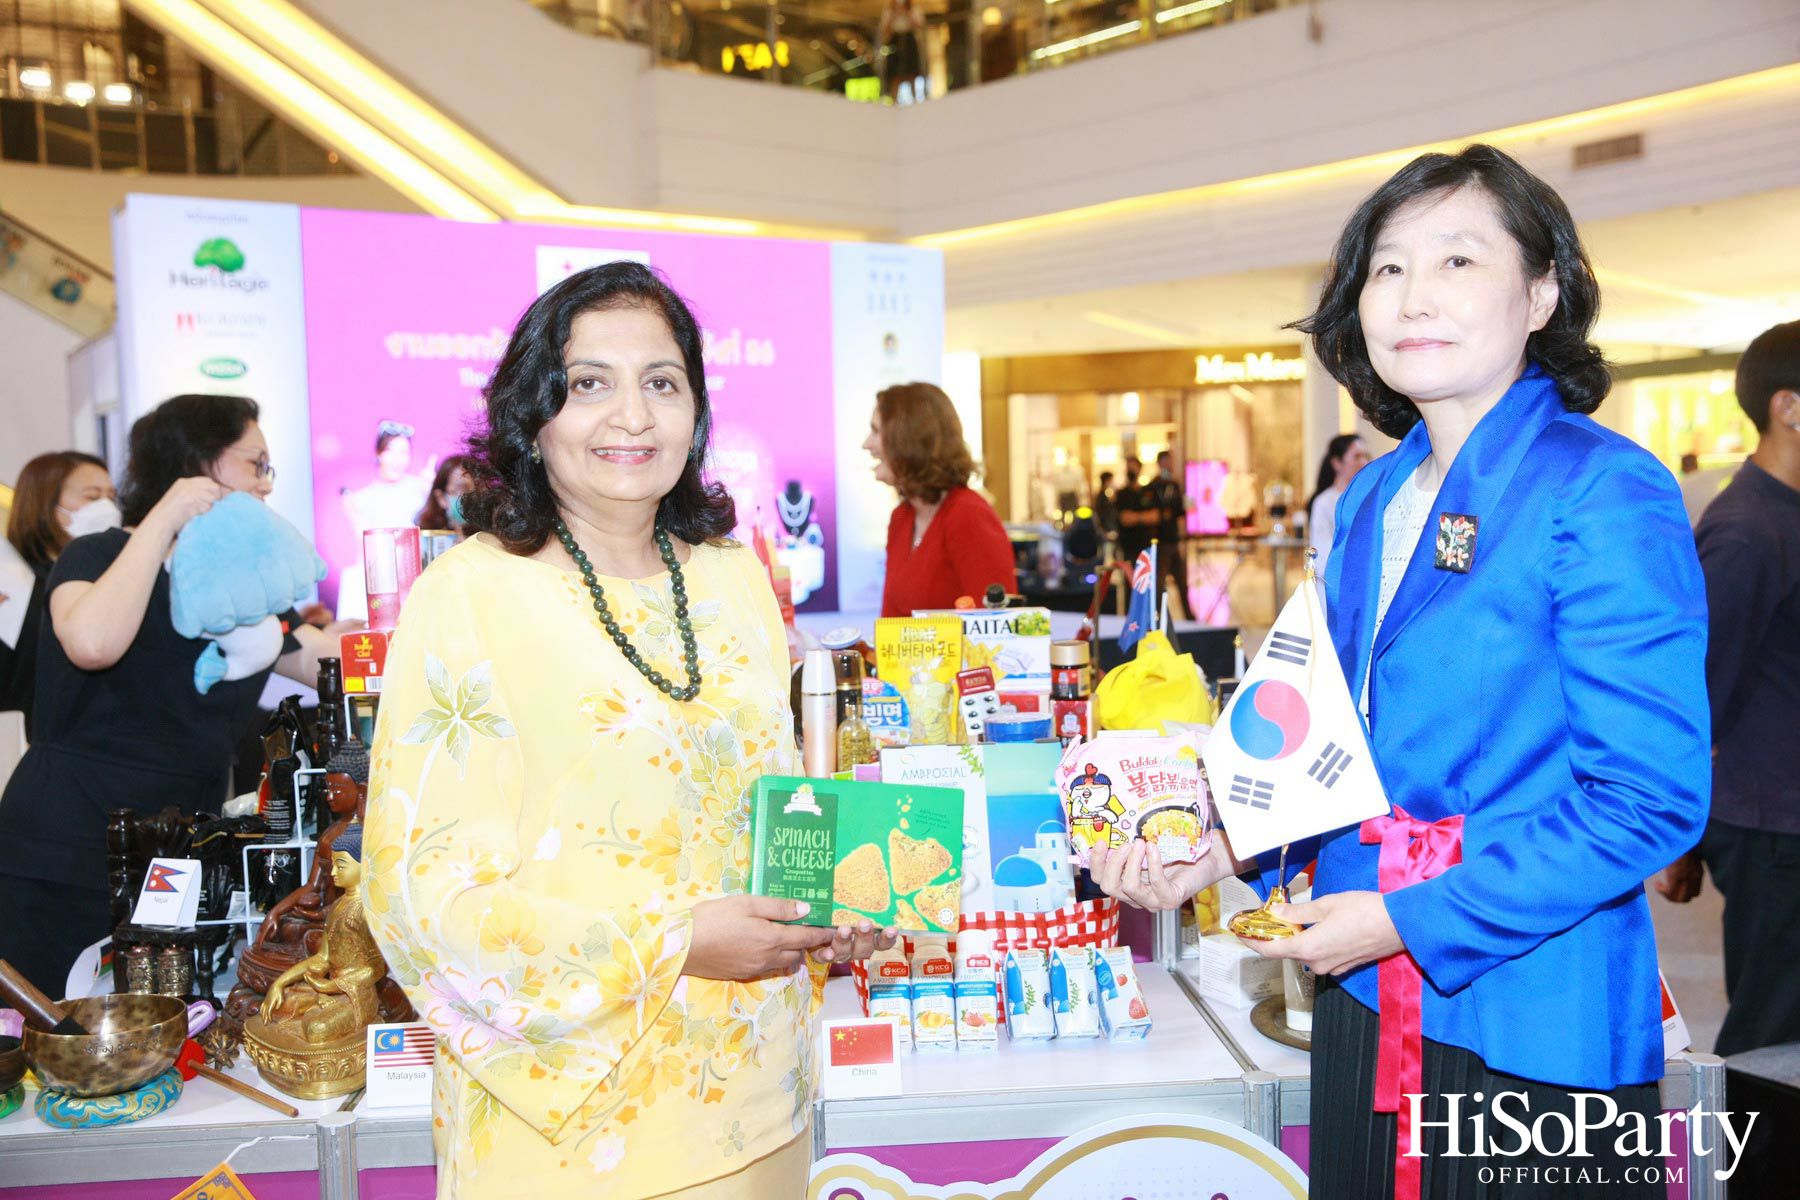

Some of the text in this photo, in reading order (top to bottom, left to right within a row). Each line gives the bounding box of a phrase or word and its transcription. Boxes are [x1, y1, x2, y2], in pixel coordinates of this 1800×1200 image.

[773, 826, 831, 850] SPINACH
[767, 845, 834, 871] & CHEESE
[387, 1071, 427, 1081] Malaysia
[852, 1067, 878, 1078] China
